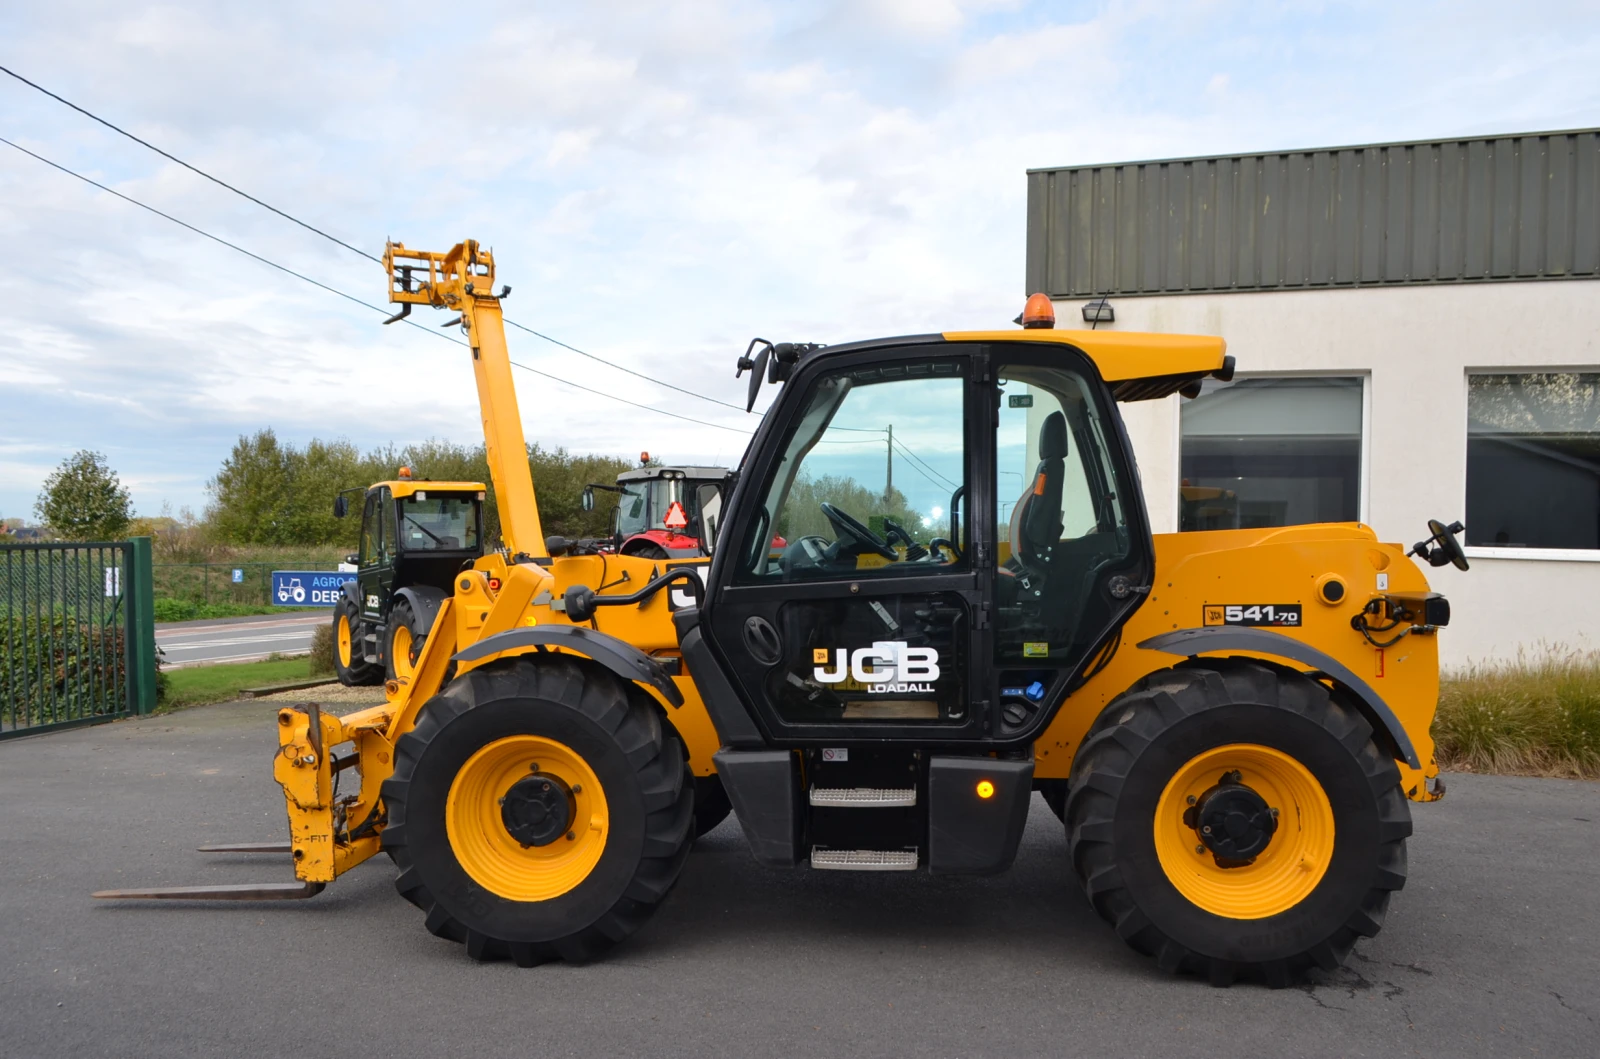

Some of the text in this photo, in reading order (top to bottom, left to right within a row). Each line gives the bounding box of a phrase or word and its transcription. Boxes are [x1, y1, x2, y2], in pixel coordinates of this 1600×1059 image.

[312, 577, 345, 587] AGRO
[312, 590, 344, 603] DEB
[1225, 606, 1298, 621] 541-70
[813, 647, 940, 683] JCB
[867, 683, 935, 693] LOADALL
